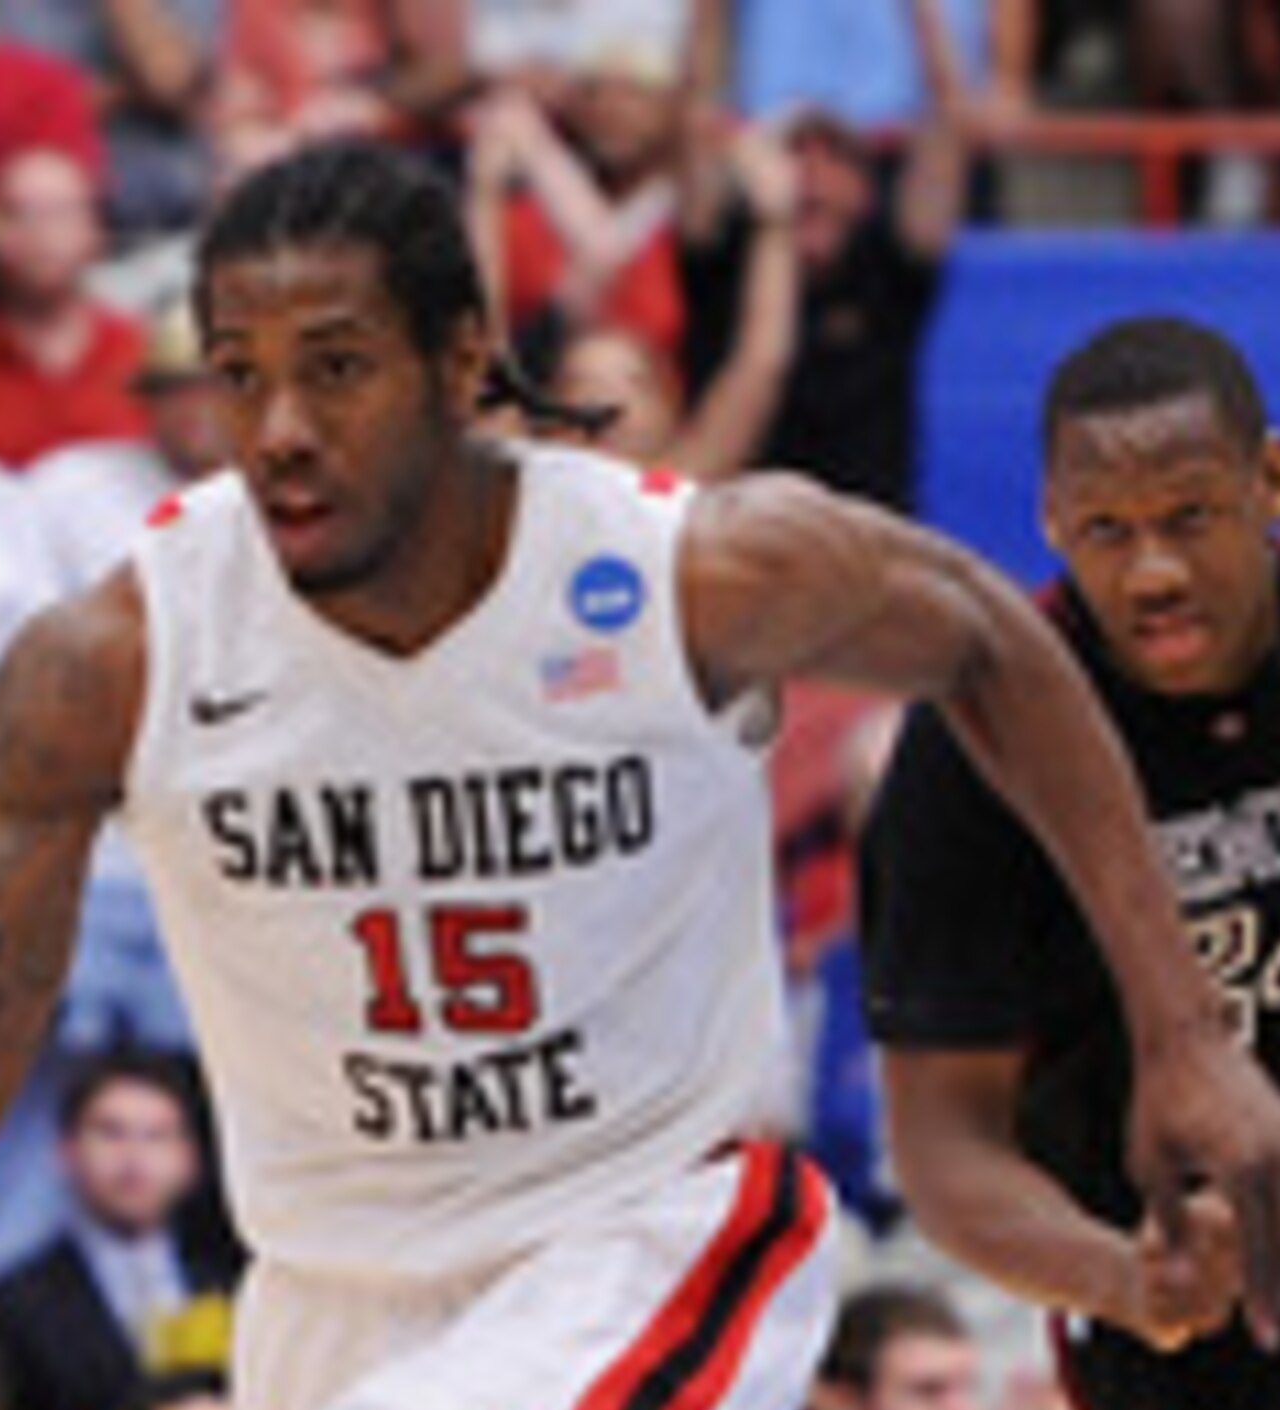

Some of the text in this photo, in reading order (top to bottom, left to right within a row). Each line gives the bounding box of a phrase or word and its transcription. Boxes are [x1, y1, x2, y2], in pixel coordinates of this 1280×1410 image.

[203, 754, 654, 886] SAN DIEGO
[350, 902, 540, 1034] 15
[342, 1030, 598, 1143] STATE
